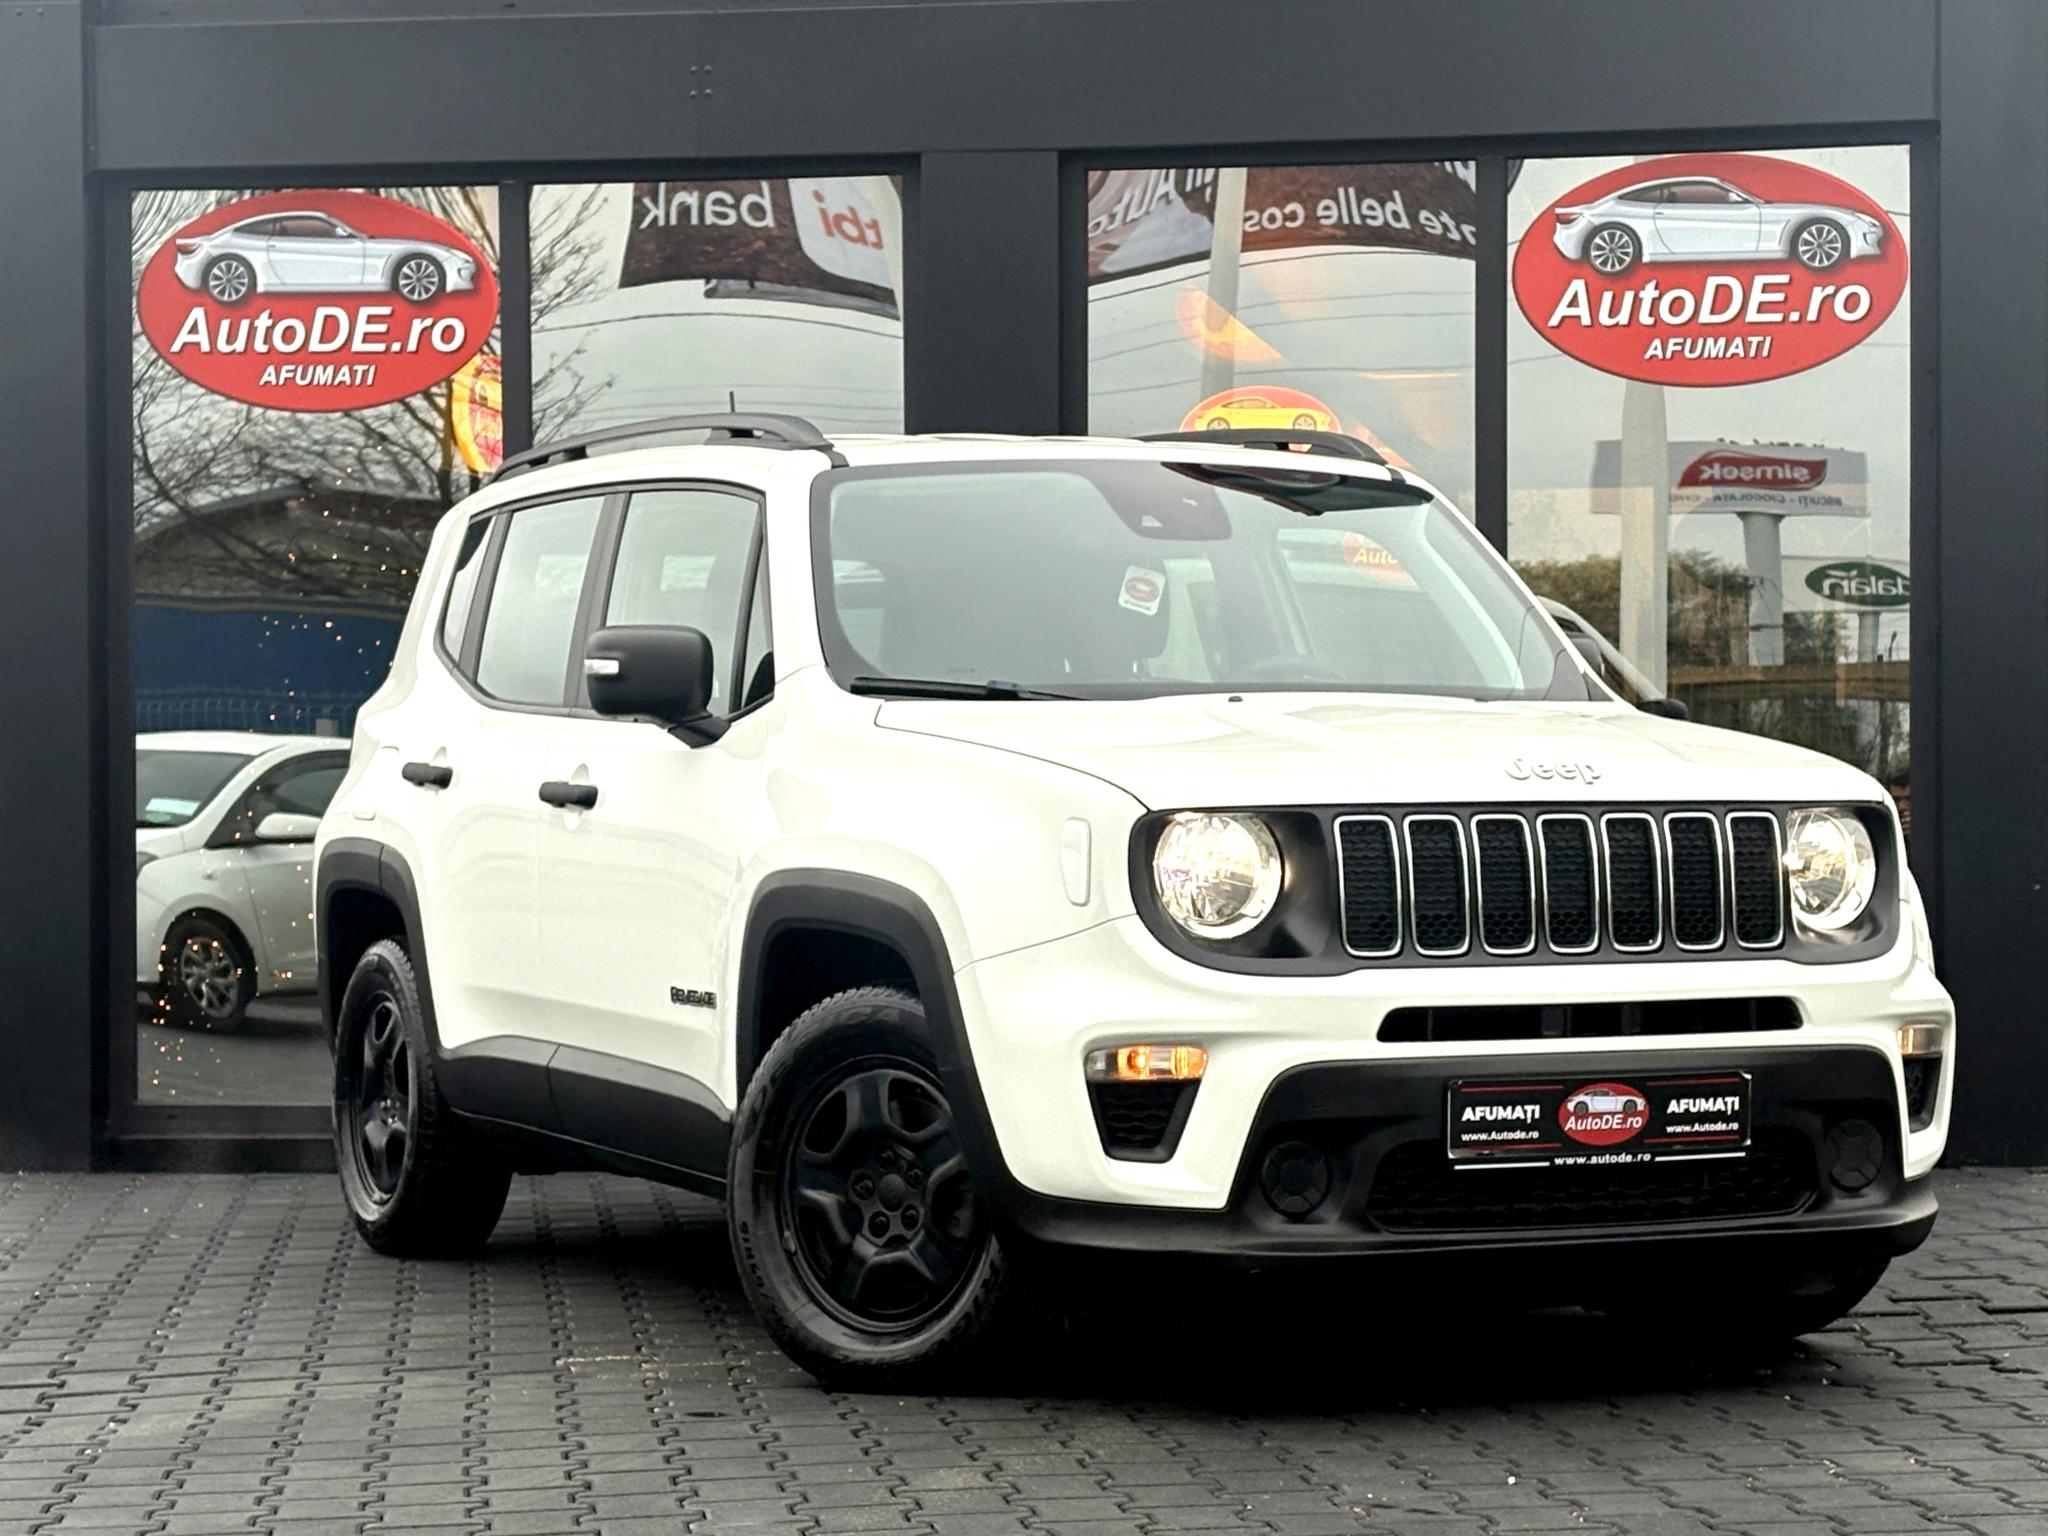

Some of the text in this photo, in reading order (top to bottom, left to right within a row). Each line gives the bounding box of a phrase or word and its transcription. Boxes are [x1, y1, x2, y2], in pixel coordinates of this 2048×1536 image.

[1547, 274, 1872, 328] AutoDE.ro
[170, 305, 466, 354] AutoDE.ro
[1644, 335, 1773, 360] AFUMATI
[259, 363, 376, 387] AFUMATI
[1505, 757, 1602, 786] Jeep
[1564, 1113, 1644, 1132] AutoDE.ro
[1460, 1129, 1540, 1142] www.Autode.ro
[1554, 1151, 1652, 1166] www.autode.ro
